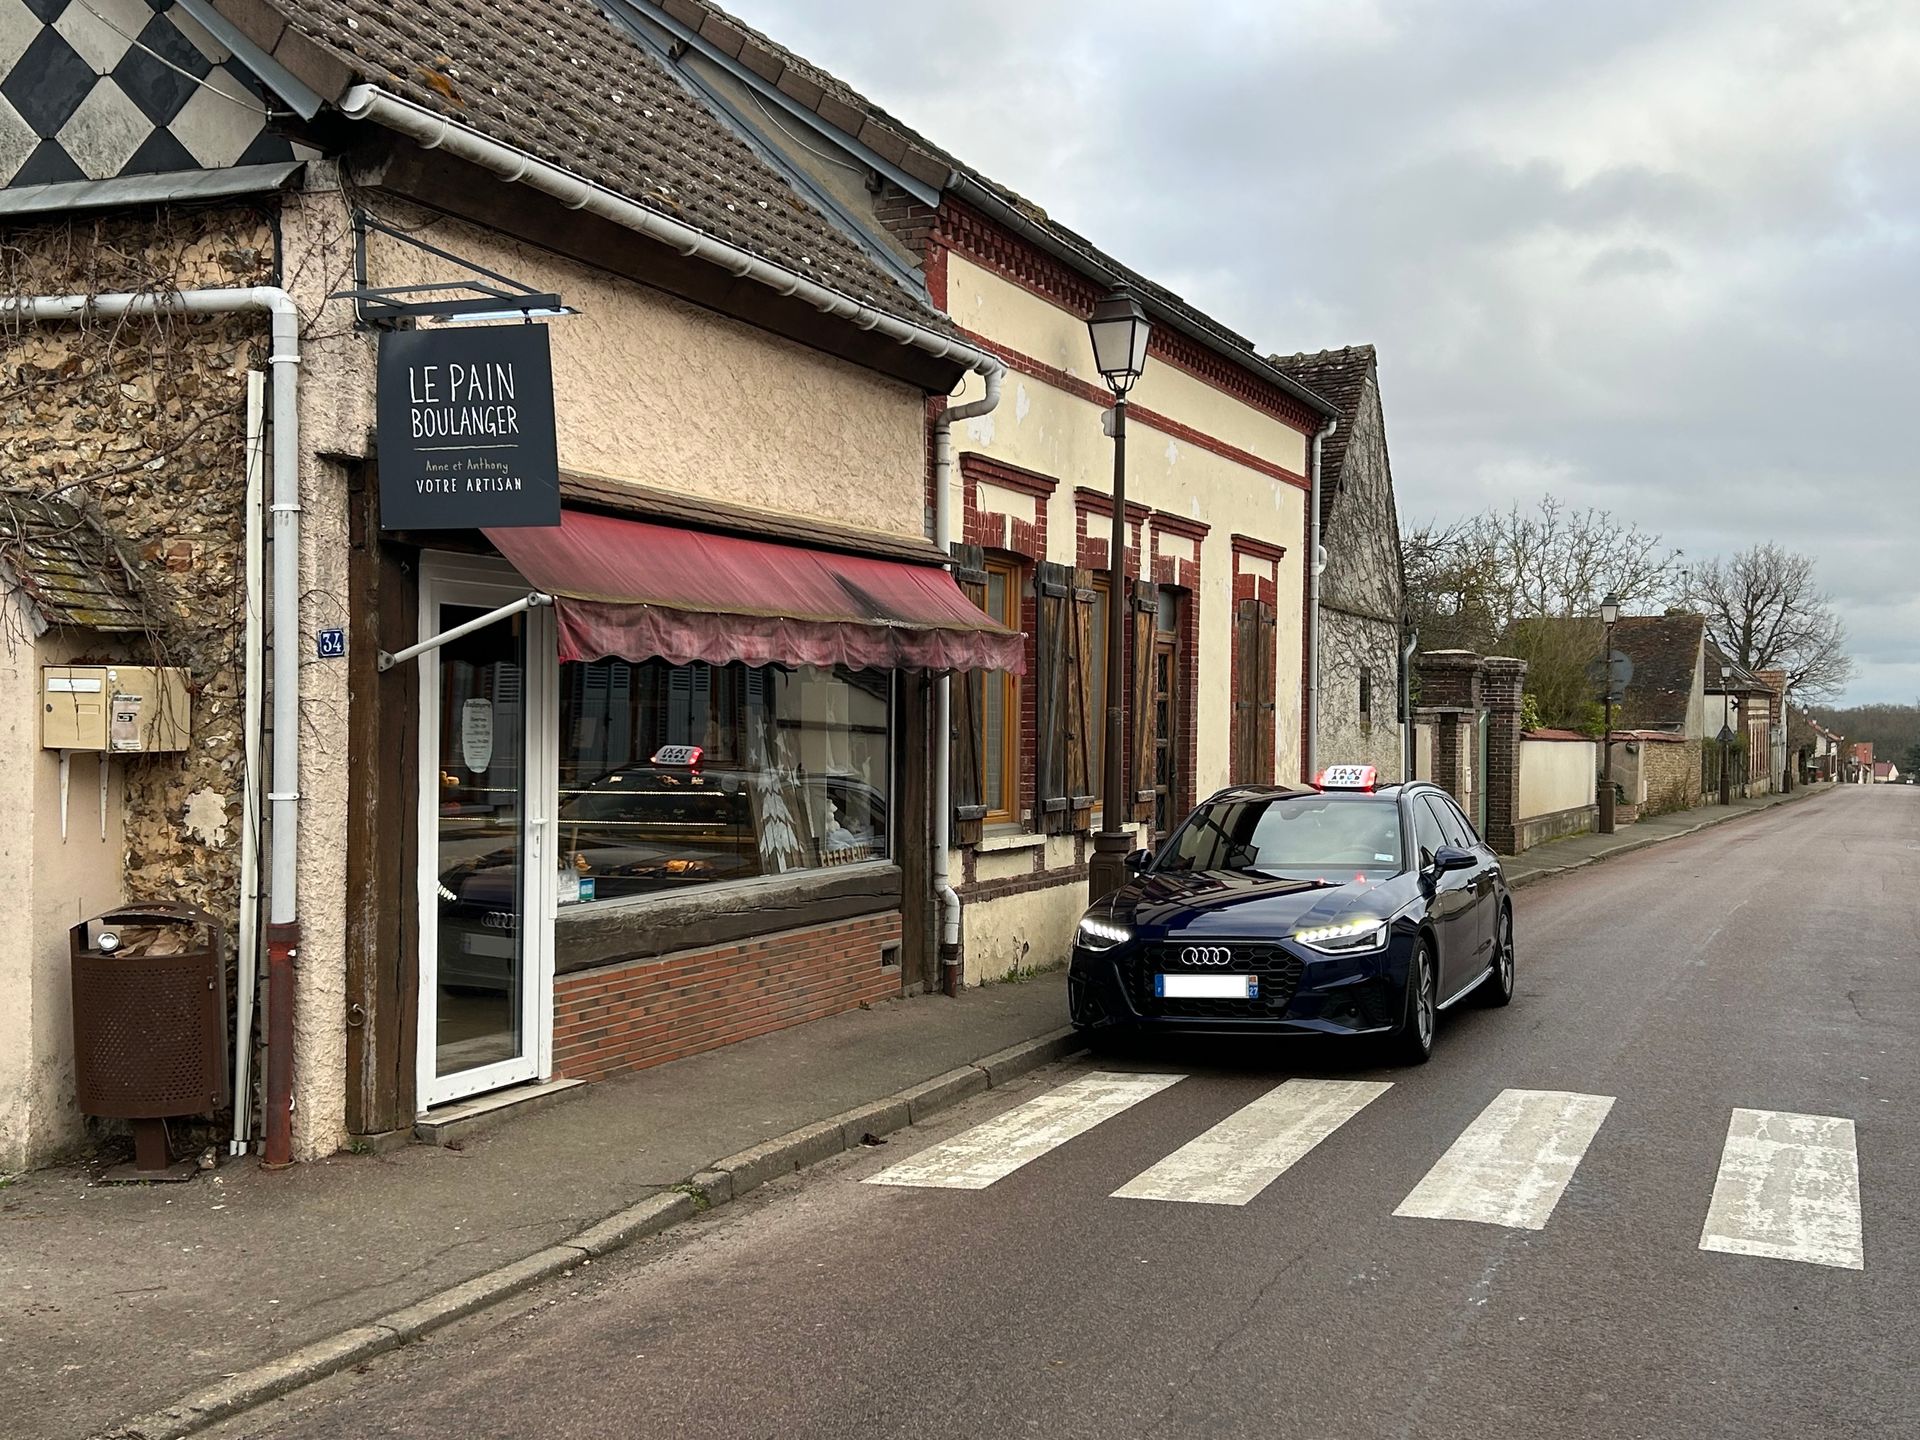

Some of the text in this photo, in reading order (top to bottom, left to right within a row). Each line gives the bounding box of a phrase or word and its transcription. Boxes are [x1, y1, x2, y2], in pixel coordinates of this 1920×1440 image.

[409, 363, 514, 403] LE PAIN
[411, 405, 519, 438] BOULANGER
[426, 457, 509, 474] Anne et Anthony
[416, 477, 522, 494] VOTRE ARTISAN
[323, 632, 341, 652] 34
[1332, 768, 1363, 776] TAXI
[1249, 986, 1258, 996] 27
